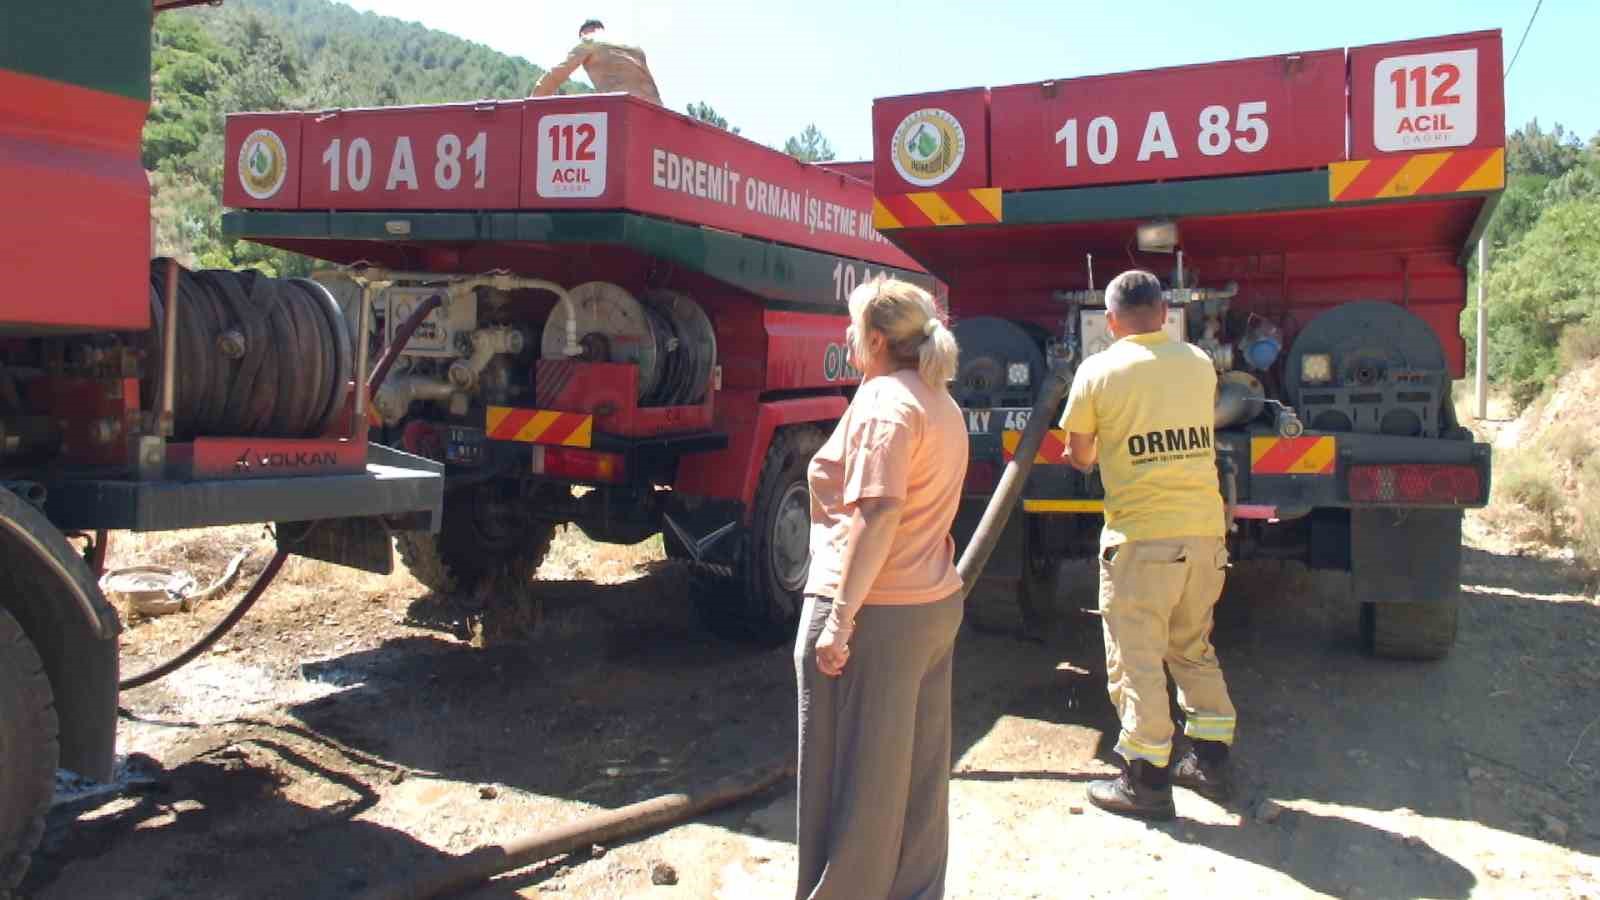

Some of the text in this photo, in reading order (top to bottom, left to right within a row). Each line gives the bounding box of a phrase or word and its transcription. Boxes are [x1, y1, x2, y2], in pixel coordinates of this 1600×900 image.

[1390, 64, 1460, 109] 112
[547, 123, 596, 161] 112
[1055, 101, 1269, 168] 10 A 85
[322, 137, 372, 192] 10
[385, 136, 419, 191] A
[434, 132, 488, 191] 81
[653, 147, 741, 207] EDREMİT
[745, 177, 801, 222] ORMAN
[804, 188, 857, 237] İŞLETME
[833, 262, 856, 301] 10
[968, 411, 1032, 432] KY 46
[1127, 425, 1211, 456] ORMAN
[256, 452, 337, 467] VOLKAN
